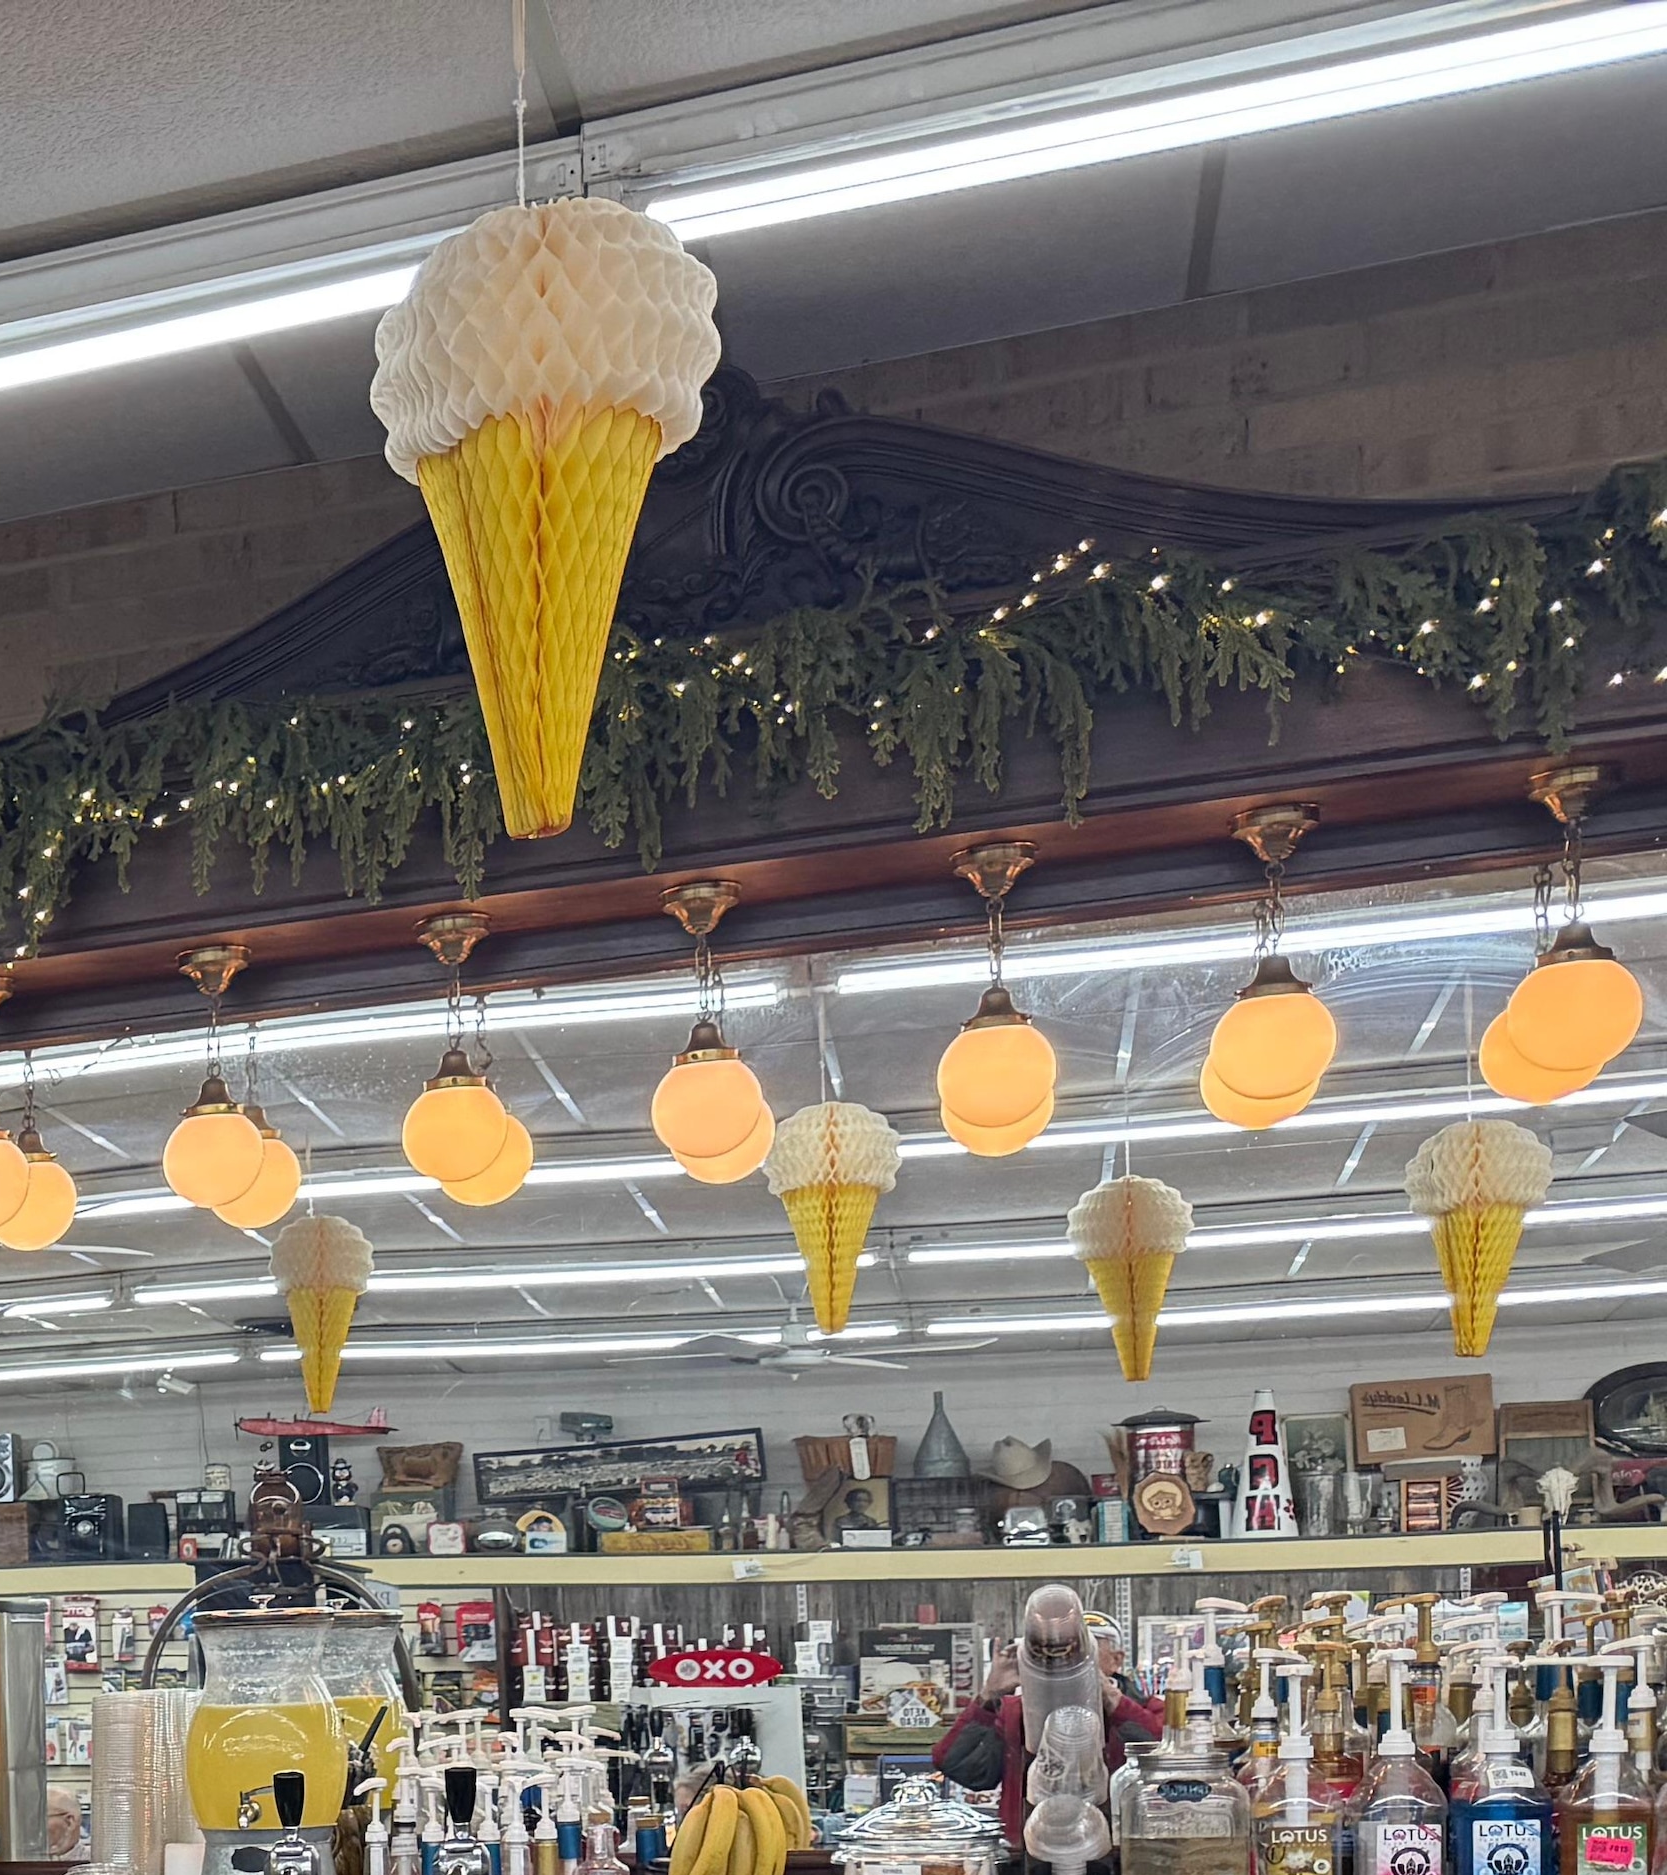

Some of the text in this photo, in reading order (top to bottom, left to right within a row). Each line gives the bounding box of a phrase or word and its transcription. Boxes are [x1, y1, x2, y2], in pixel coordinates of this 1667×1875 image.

[674, 1656, 755, 1682] OXO
[1271, 1828, 1329, 1844] LOTUS
[1581, 1826, 1644, 1841] LOTUS
